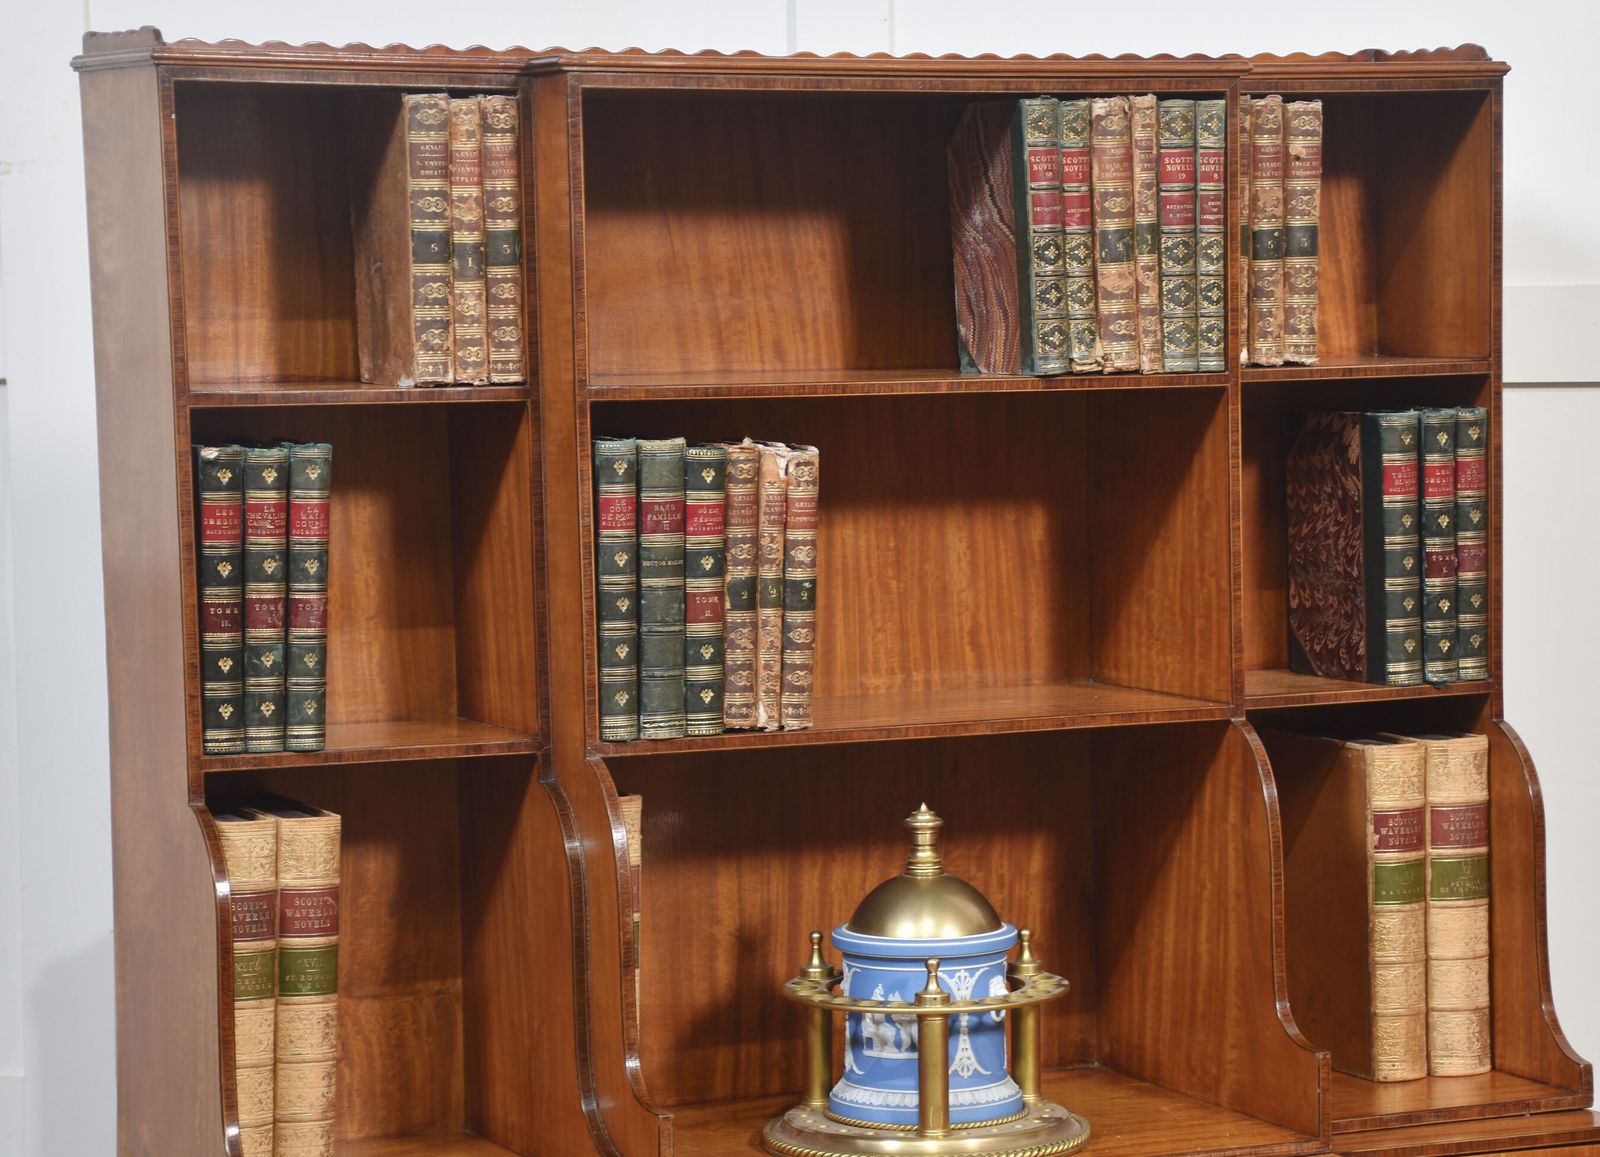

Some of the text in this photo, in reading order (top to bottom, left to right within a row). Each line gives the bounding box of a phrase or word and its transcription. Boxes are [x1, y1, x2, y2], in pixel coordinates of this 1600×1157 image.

[263, 505, 275, 513] LA
[654, 503, 676, 511] SANS
[740, 590, 748, 599] 2
[800, 591, 808, 600] 2
[695, 596, 719, 604] TOME
[209, 607, 239, 615] TOME
